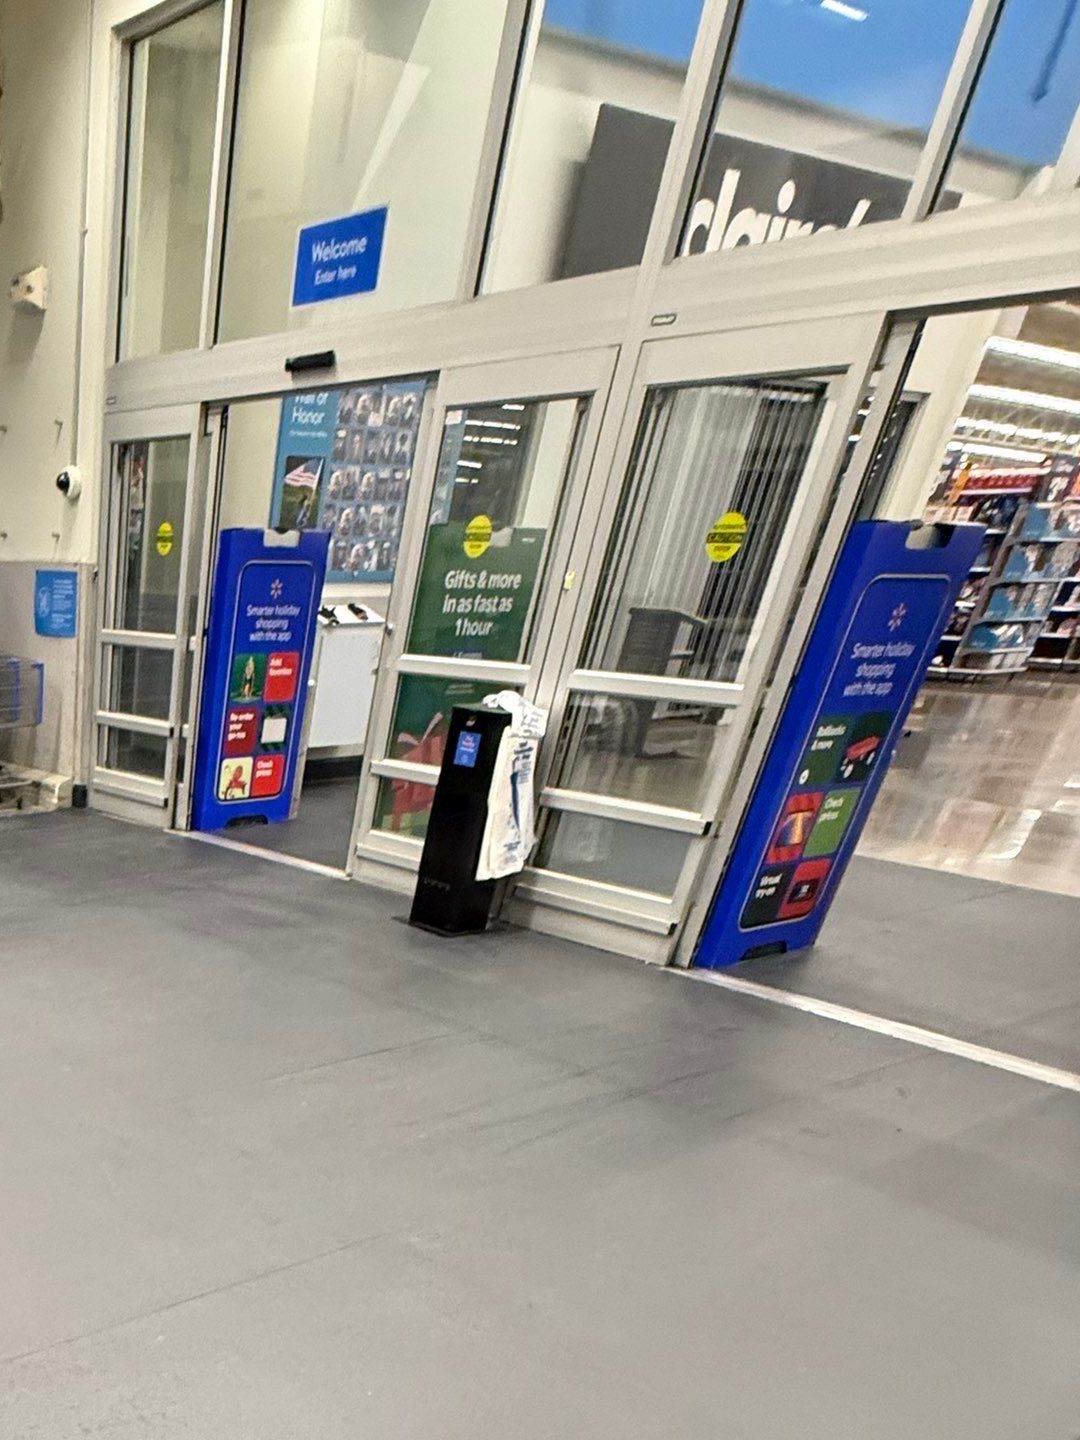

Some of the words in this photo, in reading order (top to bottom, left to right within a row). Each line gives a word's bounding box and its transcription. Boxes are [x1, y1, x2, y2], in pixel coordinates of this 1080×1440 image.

[311, 236, 368, 263] Welcome
[314, 269, 337, 286] Enter
[337, 265, 357, 281] here
[292, 406, 326, 425] Honor
[445, 570, 477, 590] Gifts
[477, 570, 488, 589] &
[487, 574, 522, 590] more
[246, 604, 275, 617] Smarter
[275, 605, 301, 617] holiday
[457, 597, 473, 614] as
[473, 594, 499, 613] fast
[498, 597, 514, 613] as
[255, 618, 289, 631] shopping
[455, 618, 462, 636] 1
[461, 618, 494, 636] hour
[850, 643, 886, 659] Smarter
[883, 642, 916, 658] holiday
[855, 662, 897, 679] shopping
